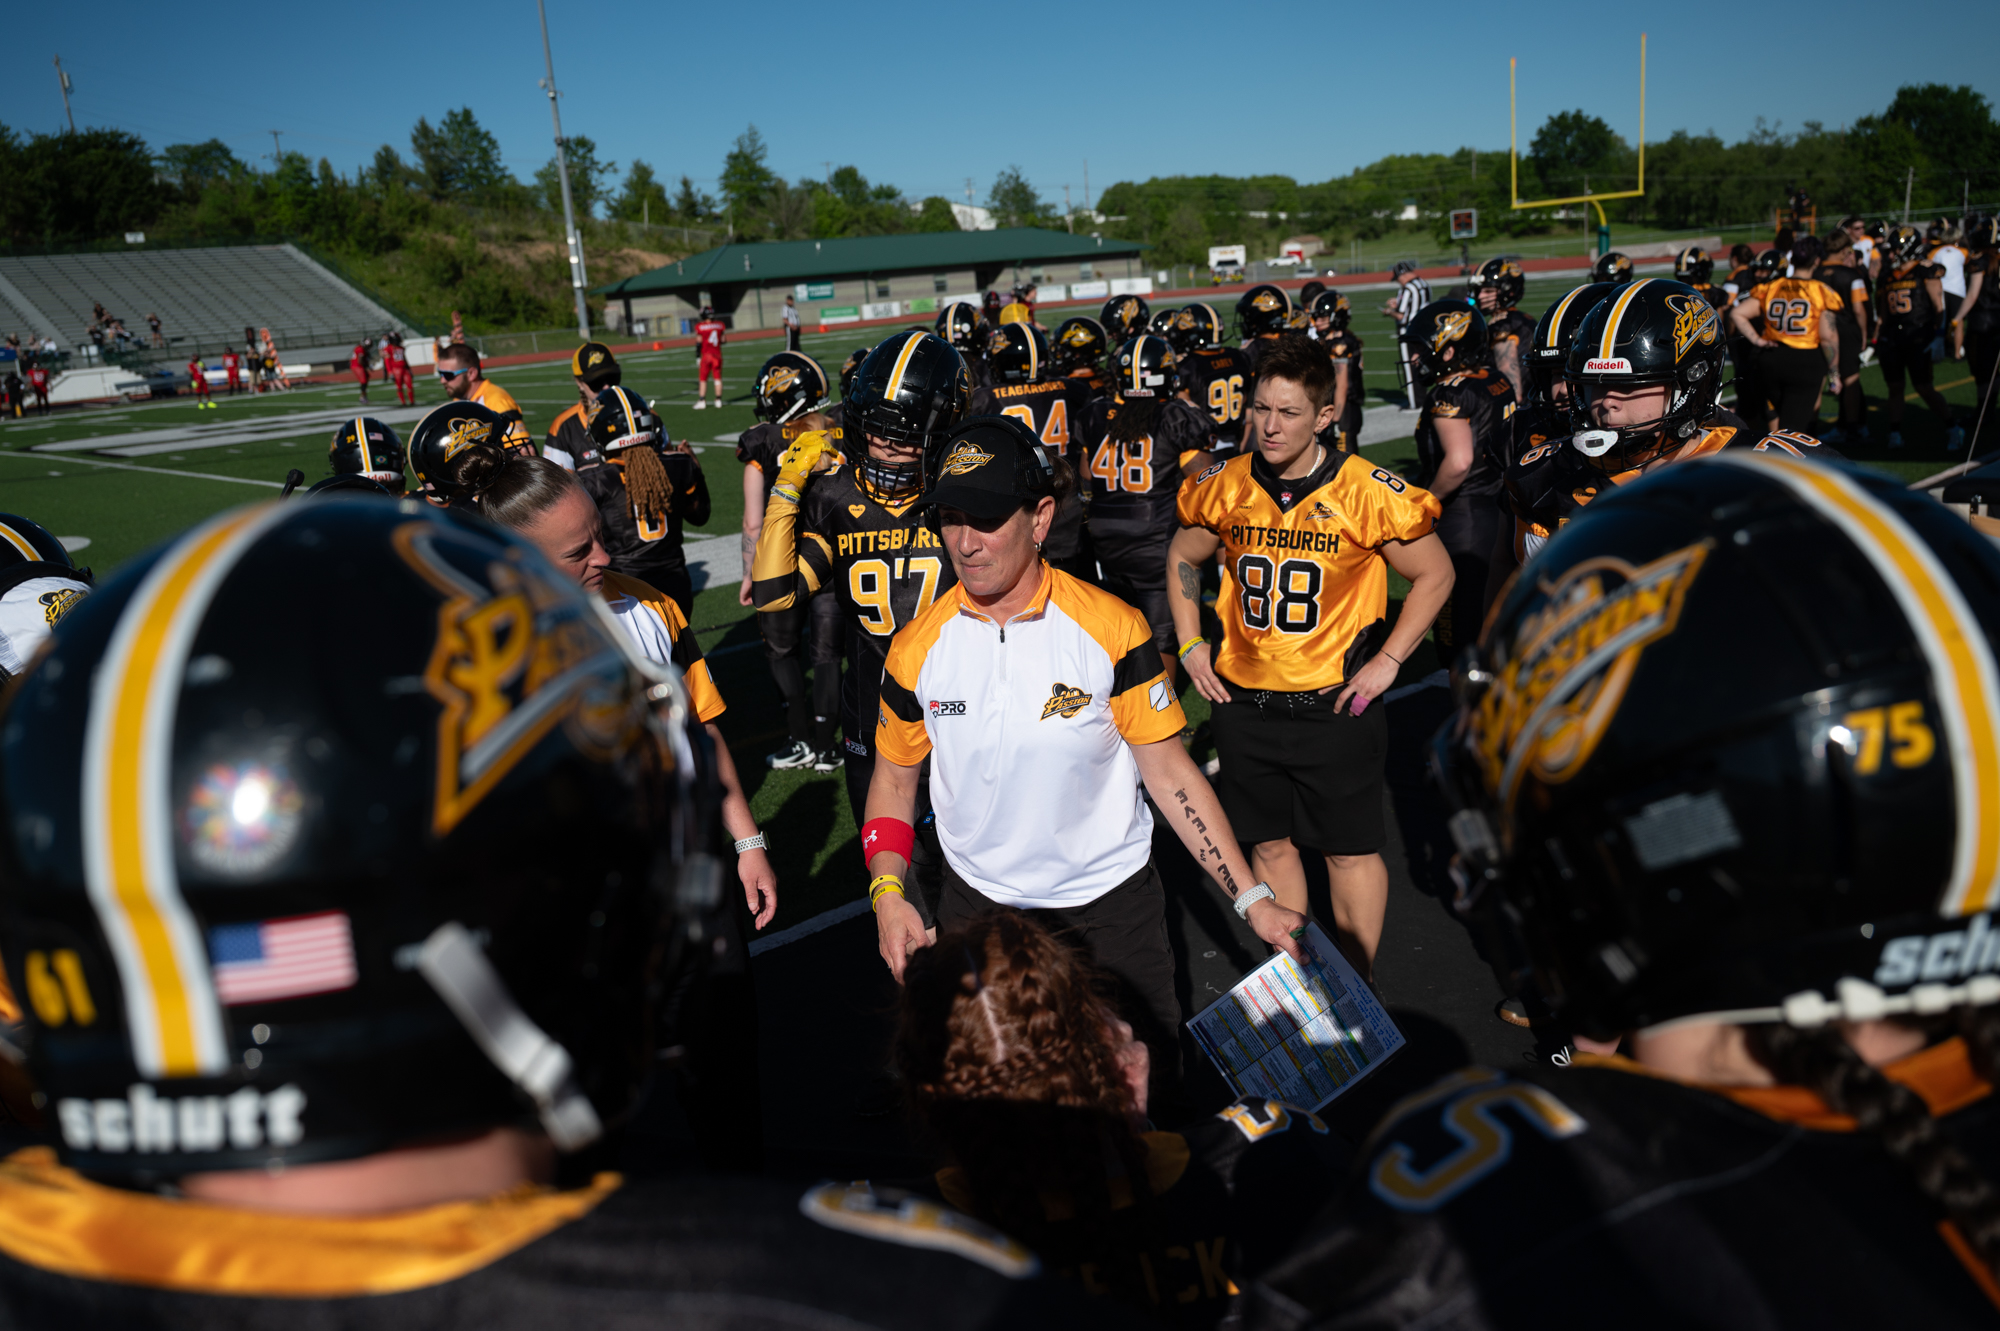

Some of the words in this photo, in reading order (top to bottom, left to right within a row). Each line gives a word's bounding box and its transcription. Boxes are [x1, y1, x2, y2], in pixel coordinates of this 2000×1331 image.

[1766, 298, 1810, 335] 92
[708, 330, 719, 347] 4
[1587, 360, 1624, 370] Riddell
[1124, 388, 1153, 397] Riddell
[1208, 374, 1244, 425] 96
[619, 433, 651, 448] Riddell
[1752, 428, 1822, 459] 76
[1090, 432, 1153, 494] 48
[1196, 460, 1227, 485] 8
[1370, 467, 1407, 494] 8
[837, 527, 942, 557] PITTSBURG
[1230, 525, 1340, 554] PITTSBURGH
[849, 556, 943, 637] 97
[1236, 553, 1324, 635] 88
[941, 703, 966, 714] PRO
[1843, 700, 1937, 776] 75
[1873, 912, 2000, 989] sch
[24, 948, 98, 1029] 61
[56, 1082, 308, 1155] schutt
